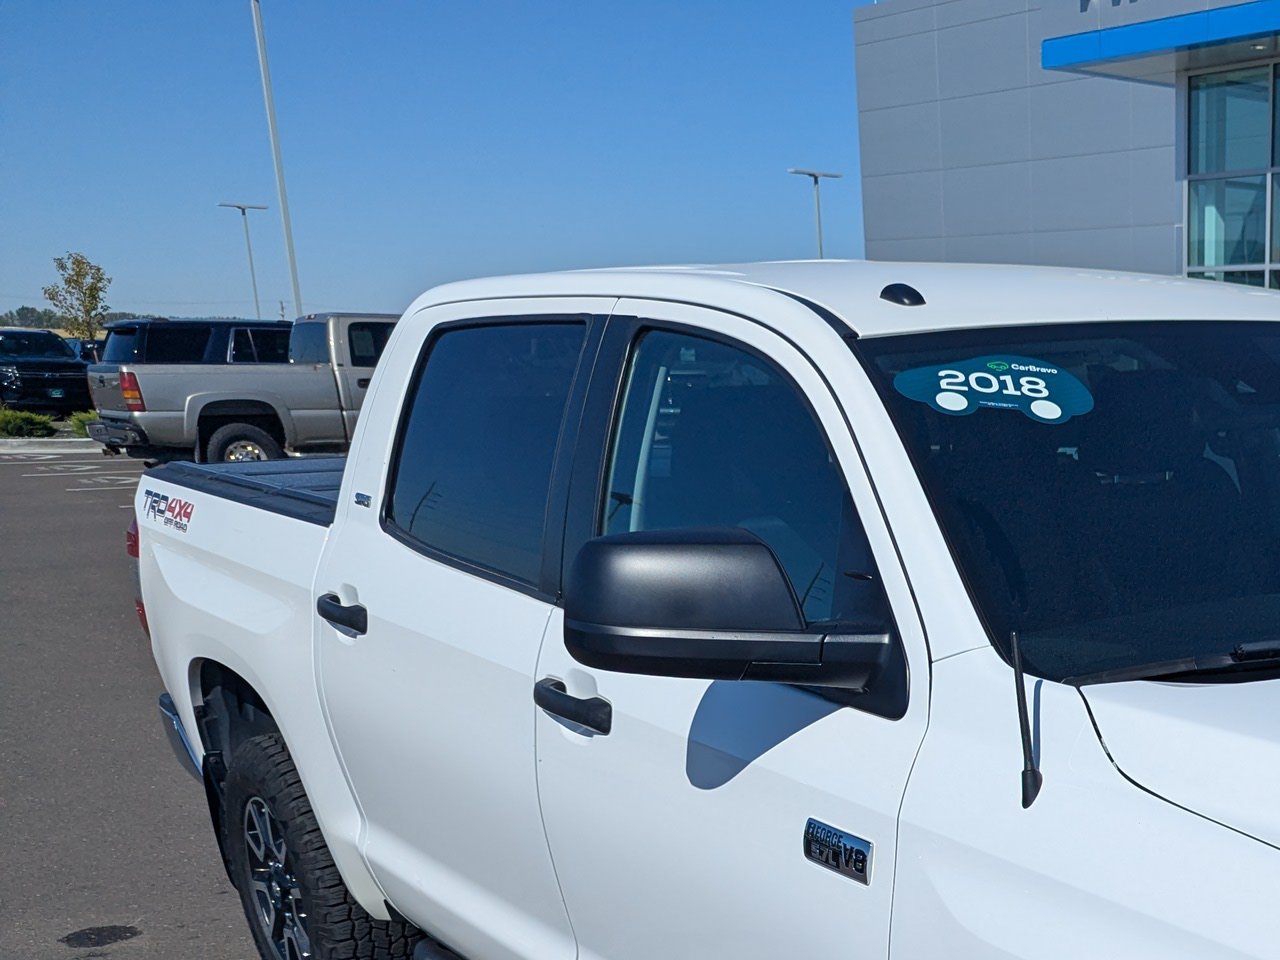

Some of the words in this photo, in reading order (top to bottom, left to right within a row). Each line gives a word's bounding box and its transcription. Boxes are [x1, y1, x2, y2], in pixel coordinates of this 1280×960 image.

[937, 369, 1050, 398] 2018
[1011, 363, 1058, 374] CarBravo
[143, 489, 169, 521] TRD
[842, 842, 868, 874] V8
